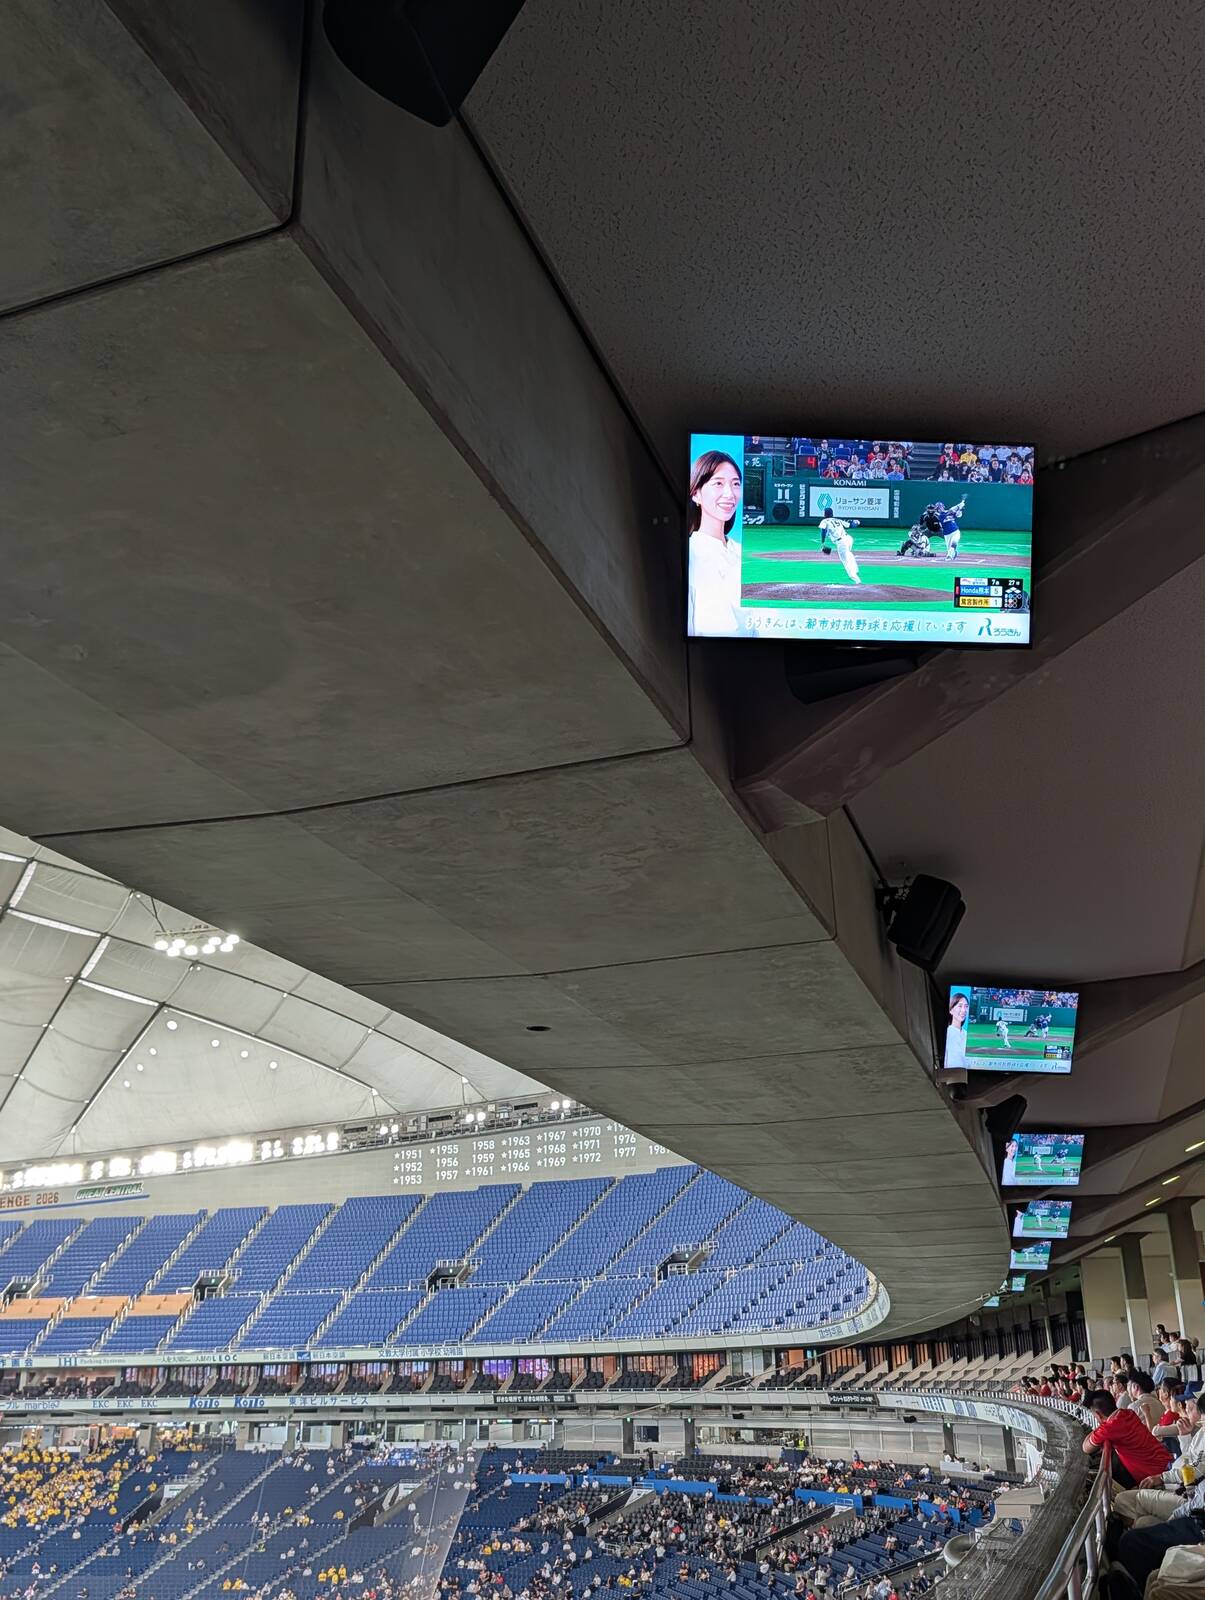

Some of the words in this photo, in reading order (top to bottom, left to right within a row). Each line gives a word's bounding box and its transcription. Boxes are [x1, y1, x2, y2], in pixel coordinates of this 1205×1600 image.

[960, 586, 989, 594] Honda熊本
[993, 628, 1022, 637] ろうきん
[544, 1131, 566, 1142] 1967
[578, 1126, 601, 1137] 1970
[508, 1136, 530, 1146] 1963
[614, 1134, 636, 1145] 1976
[436, 1144, 458, 1155] 1955
[472, 1140, 495, 1150] 1958
[544, 1144, 566, 1154] 1968
[578, 1140, 600, 1150] 1971
[649, 1144, 670, 1155] 198
[400, 1150, 422, 1160] 1951
[508, 1149, 530, 1159] 1965
[579, 1152, 601, 1163] 1972
[614, 1147, 636, 1158] 1977
[436, 1158, 458, 1168] 1956
[472, 1153, 494, 1163] 1959
[544, 1157, 566, 1167] 1969
[400, 1162, 422, 1172] 1952
[472, 1166, 494, 1176] 1961
[508, 1162, 530, 1172] 1966
[400, 1175, 422, 1185] 1953
[436, 1170, 458, 1180] 1957
[76, 1187, 104, 1200] GREAT
[104, 1182, 144, 1197] CENTRAL
[0, 1194, 31, 1208] ENGE
[36, 1192, 59, 1205] 2026
[58, 1357, 78, 1366] IHI
[289, 1396, 368, 1405] 東洋ビルサービス
